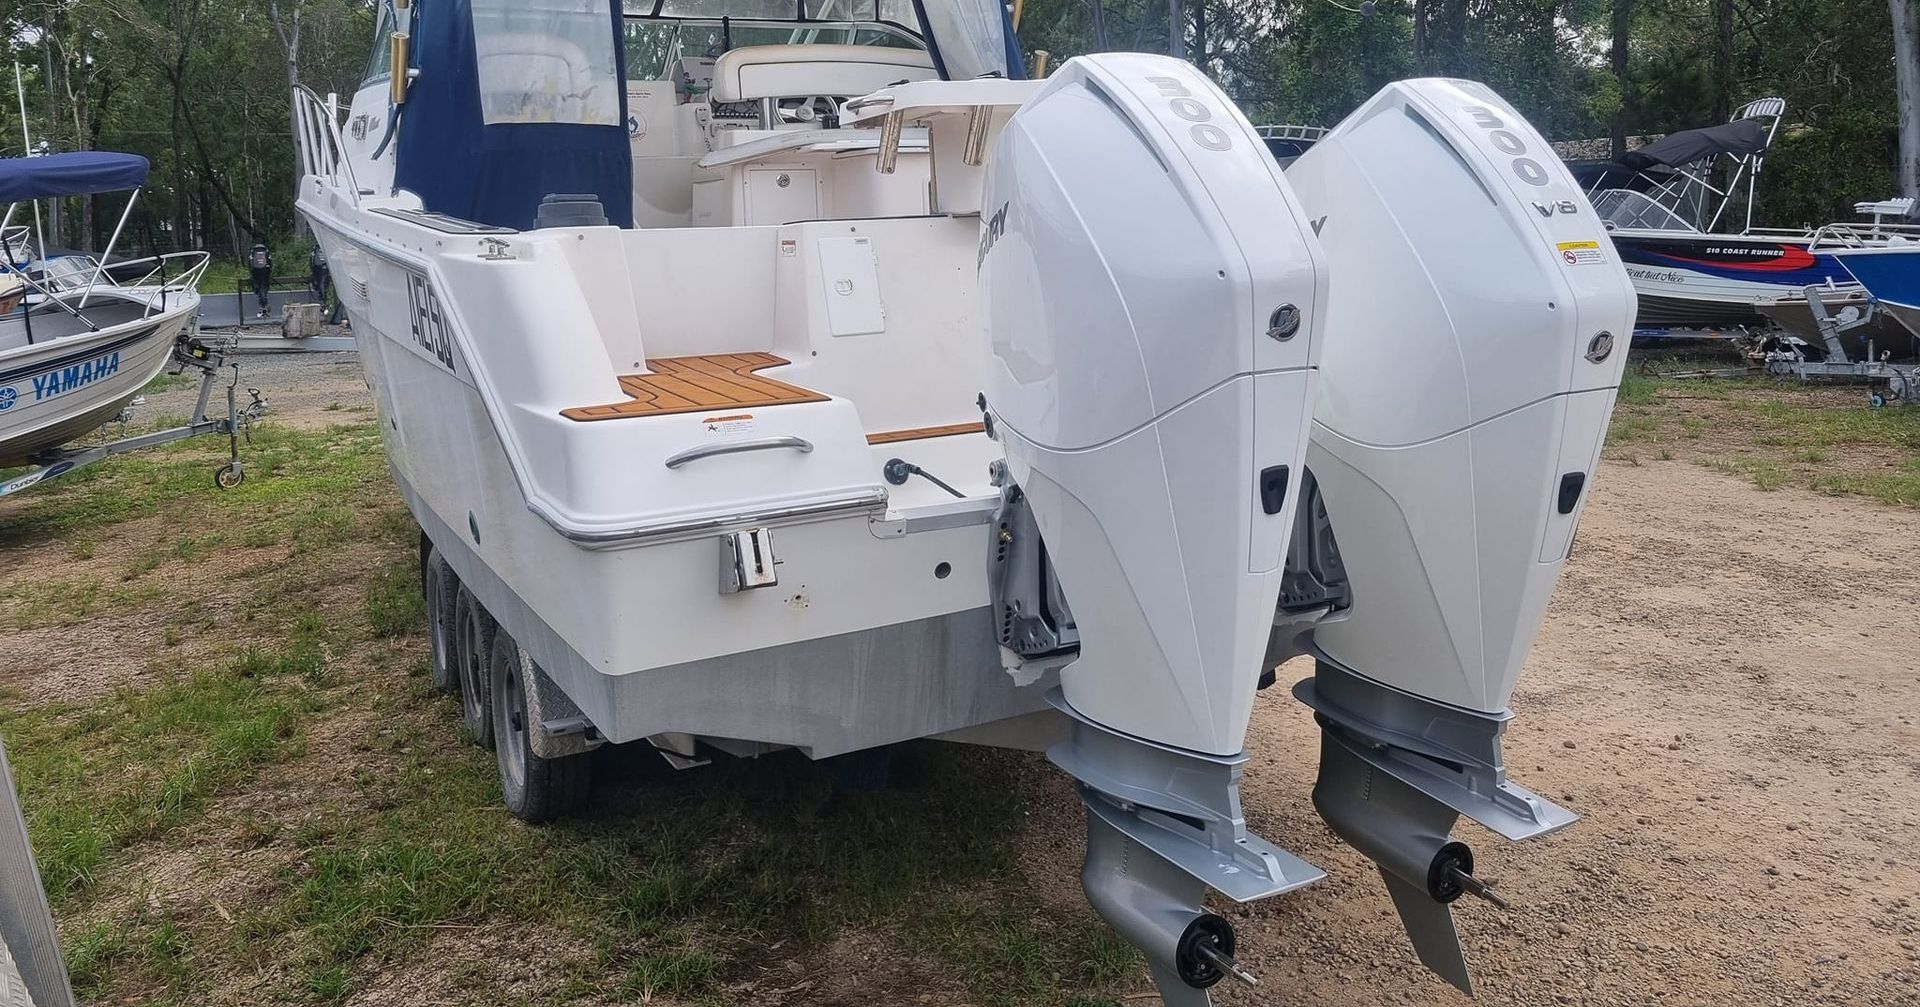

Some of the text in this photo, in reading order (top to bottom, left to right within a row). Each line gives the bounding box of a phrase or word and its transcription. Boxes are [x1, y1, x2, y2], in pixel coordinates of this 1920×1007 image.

[1145, 76, 1232, 152] 300
[1461, 105, 1549, 187] 300
[1531, 200, 1578, 218] V8
[1750, 249, 1785, 257] RUNNER
[32, 352, 119, 400] YAMAHA
